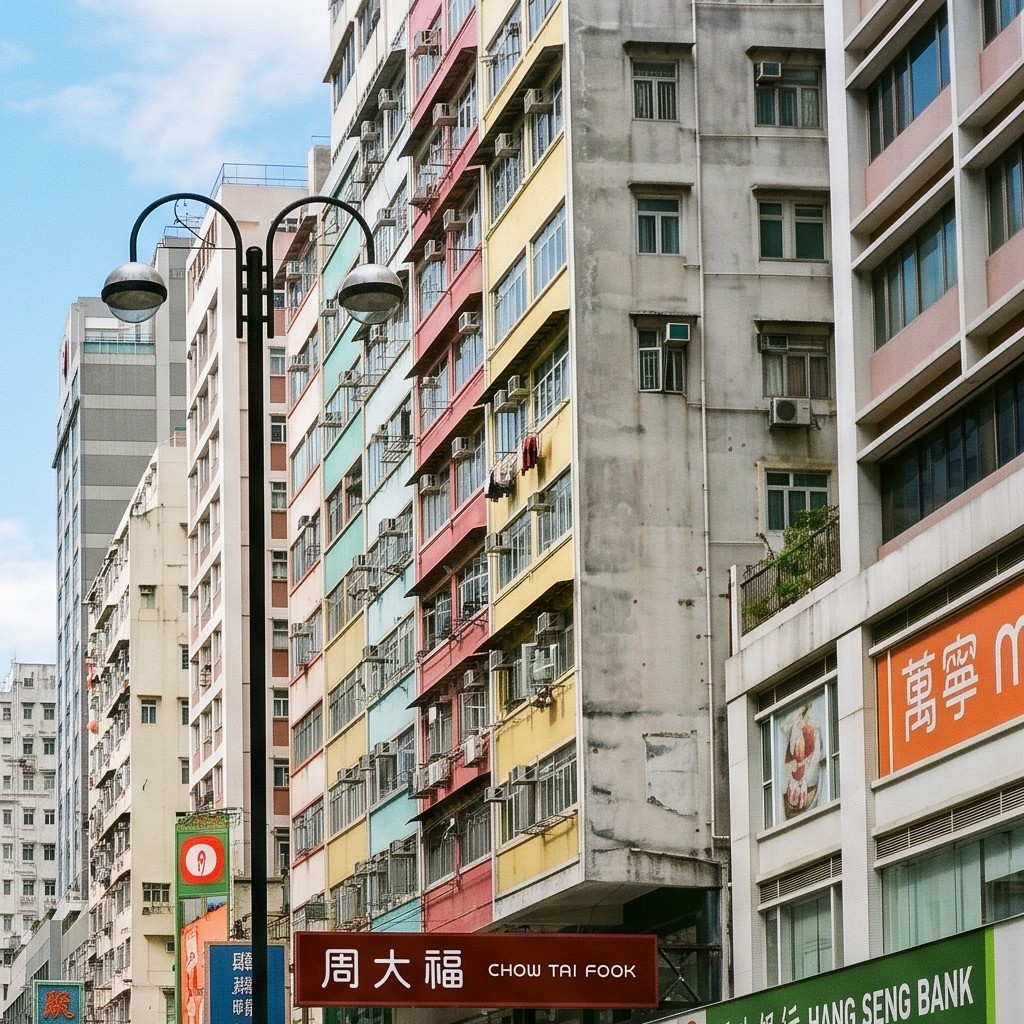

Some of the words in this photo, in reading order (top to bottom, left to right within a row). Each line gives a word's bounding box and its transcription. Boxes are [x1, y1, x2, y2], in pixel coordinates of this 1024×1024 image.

[901, 633, 979, 743] 萬寧
[321, 949, 464, 989] 周大福
[488, 963, 541, 978] CHOW
[548, 963, 577, 978] TAI
[585, 964, 637, 979] FOOK
[917, 965, 975, 1016] BANK
